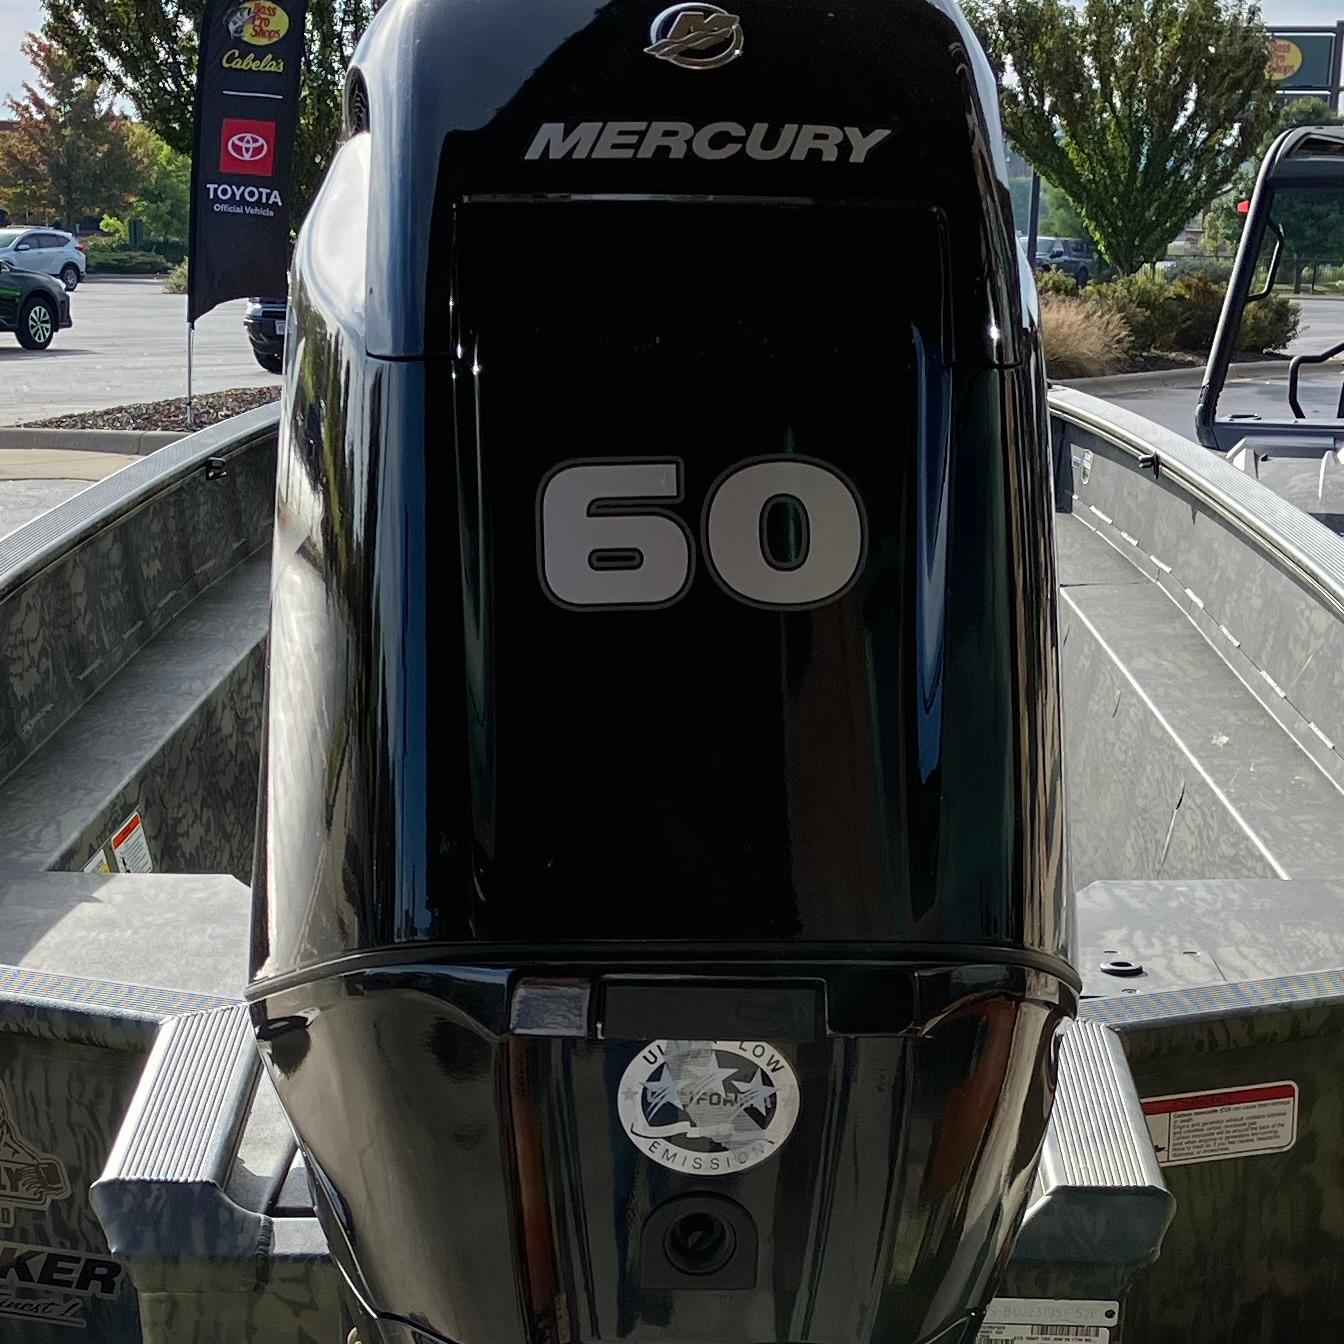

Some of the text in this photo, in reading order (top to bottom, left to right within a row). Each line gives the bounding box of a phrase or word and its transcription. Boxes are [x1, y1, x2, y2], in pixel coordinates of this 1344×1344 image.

[253, 2, 276, 17] Bass
[250, 16, 270, 28] Pro
[250, 25, 281, 41] Shops
[221, 49, 285, 73] Cabela's
[524, 121, 892, 163] MERCURY
[206, 183, 283, 207] TOYOTA
[213, 203, 275, 217] Official Vehicle
[534, 453, 869, 612] 60
[738, 1040, 786, 1074] LOW
